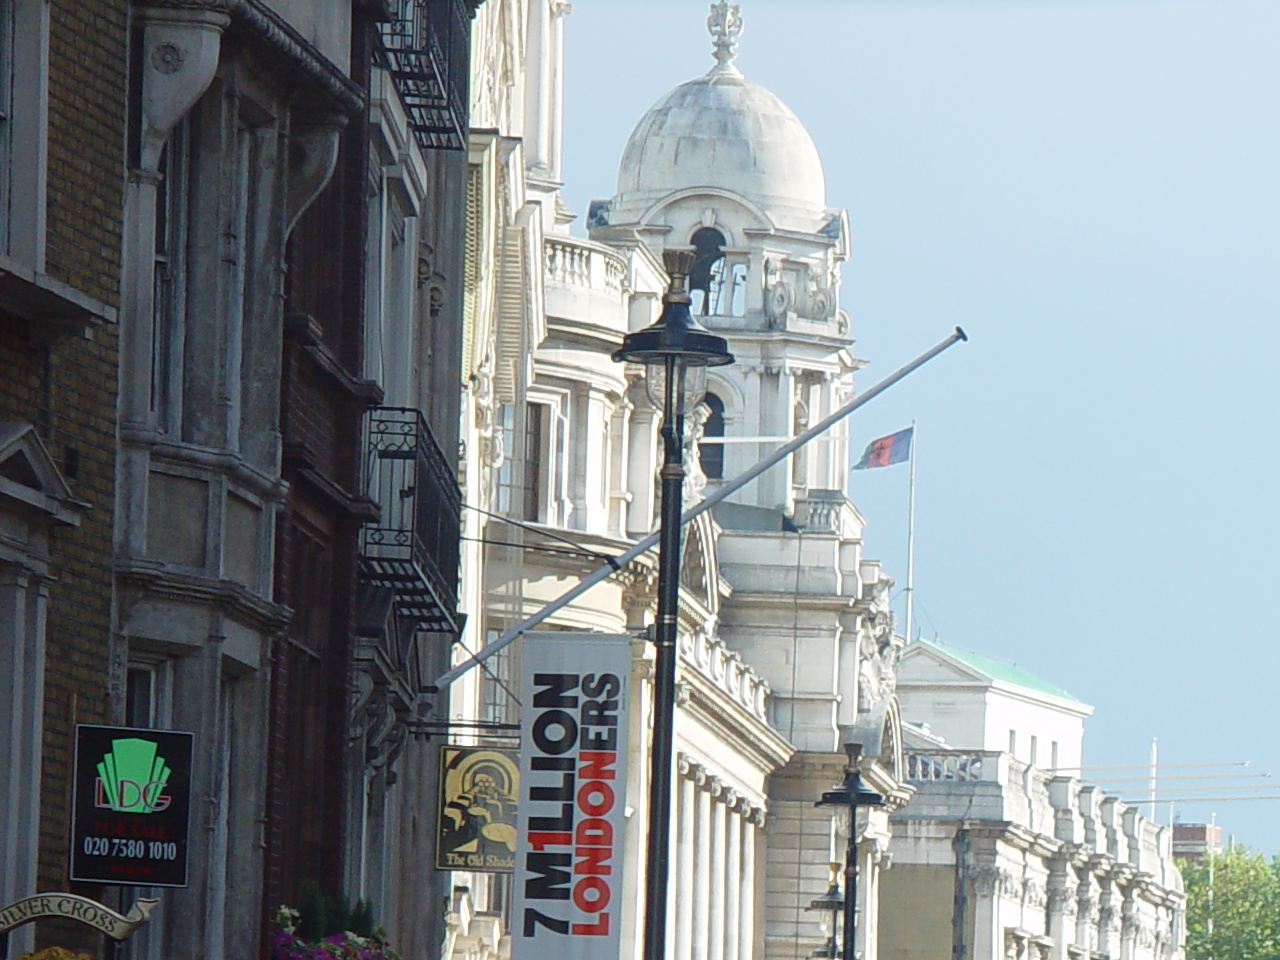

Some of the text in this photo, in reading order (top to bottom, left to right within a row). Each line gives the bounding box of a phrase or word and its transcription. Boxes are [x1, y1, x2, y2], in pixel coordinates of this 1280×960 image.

[94, 777, 172, 812] LDG
[571, 673, 621, 937] LONDONERS
[84, 836, 177, 861] 020 7580 1010
[446, 853, 466, 866] The
[468, 854, 485, 867] Old
[57, 899, 118, 933] CROSS
[523, 908, 570, 937] 7
